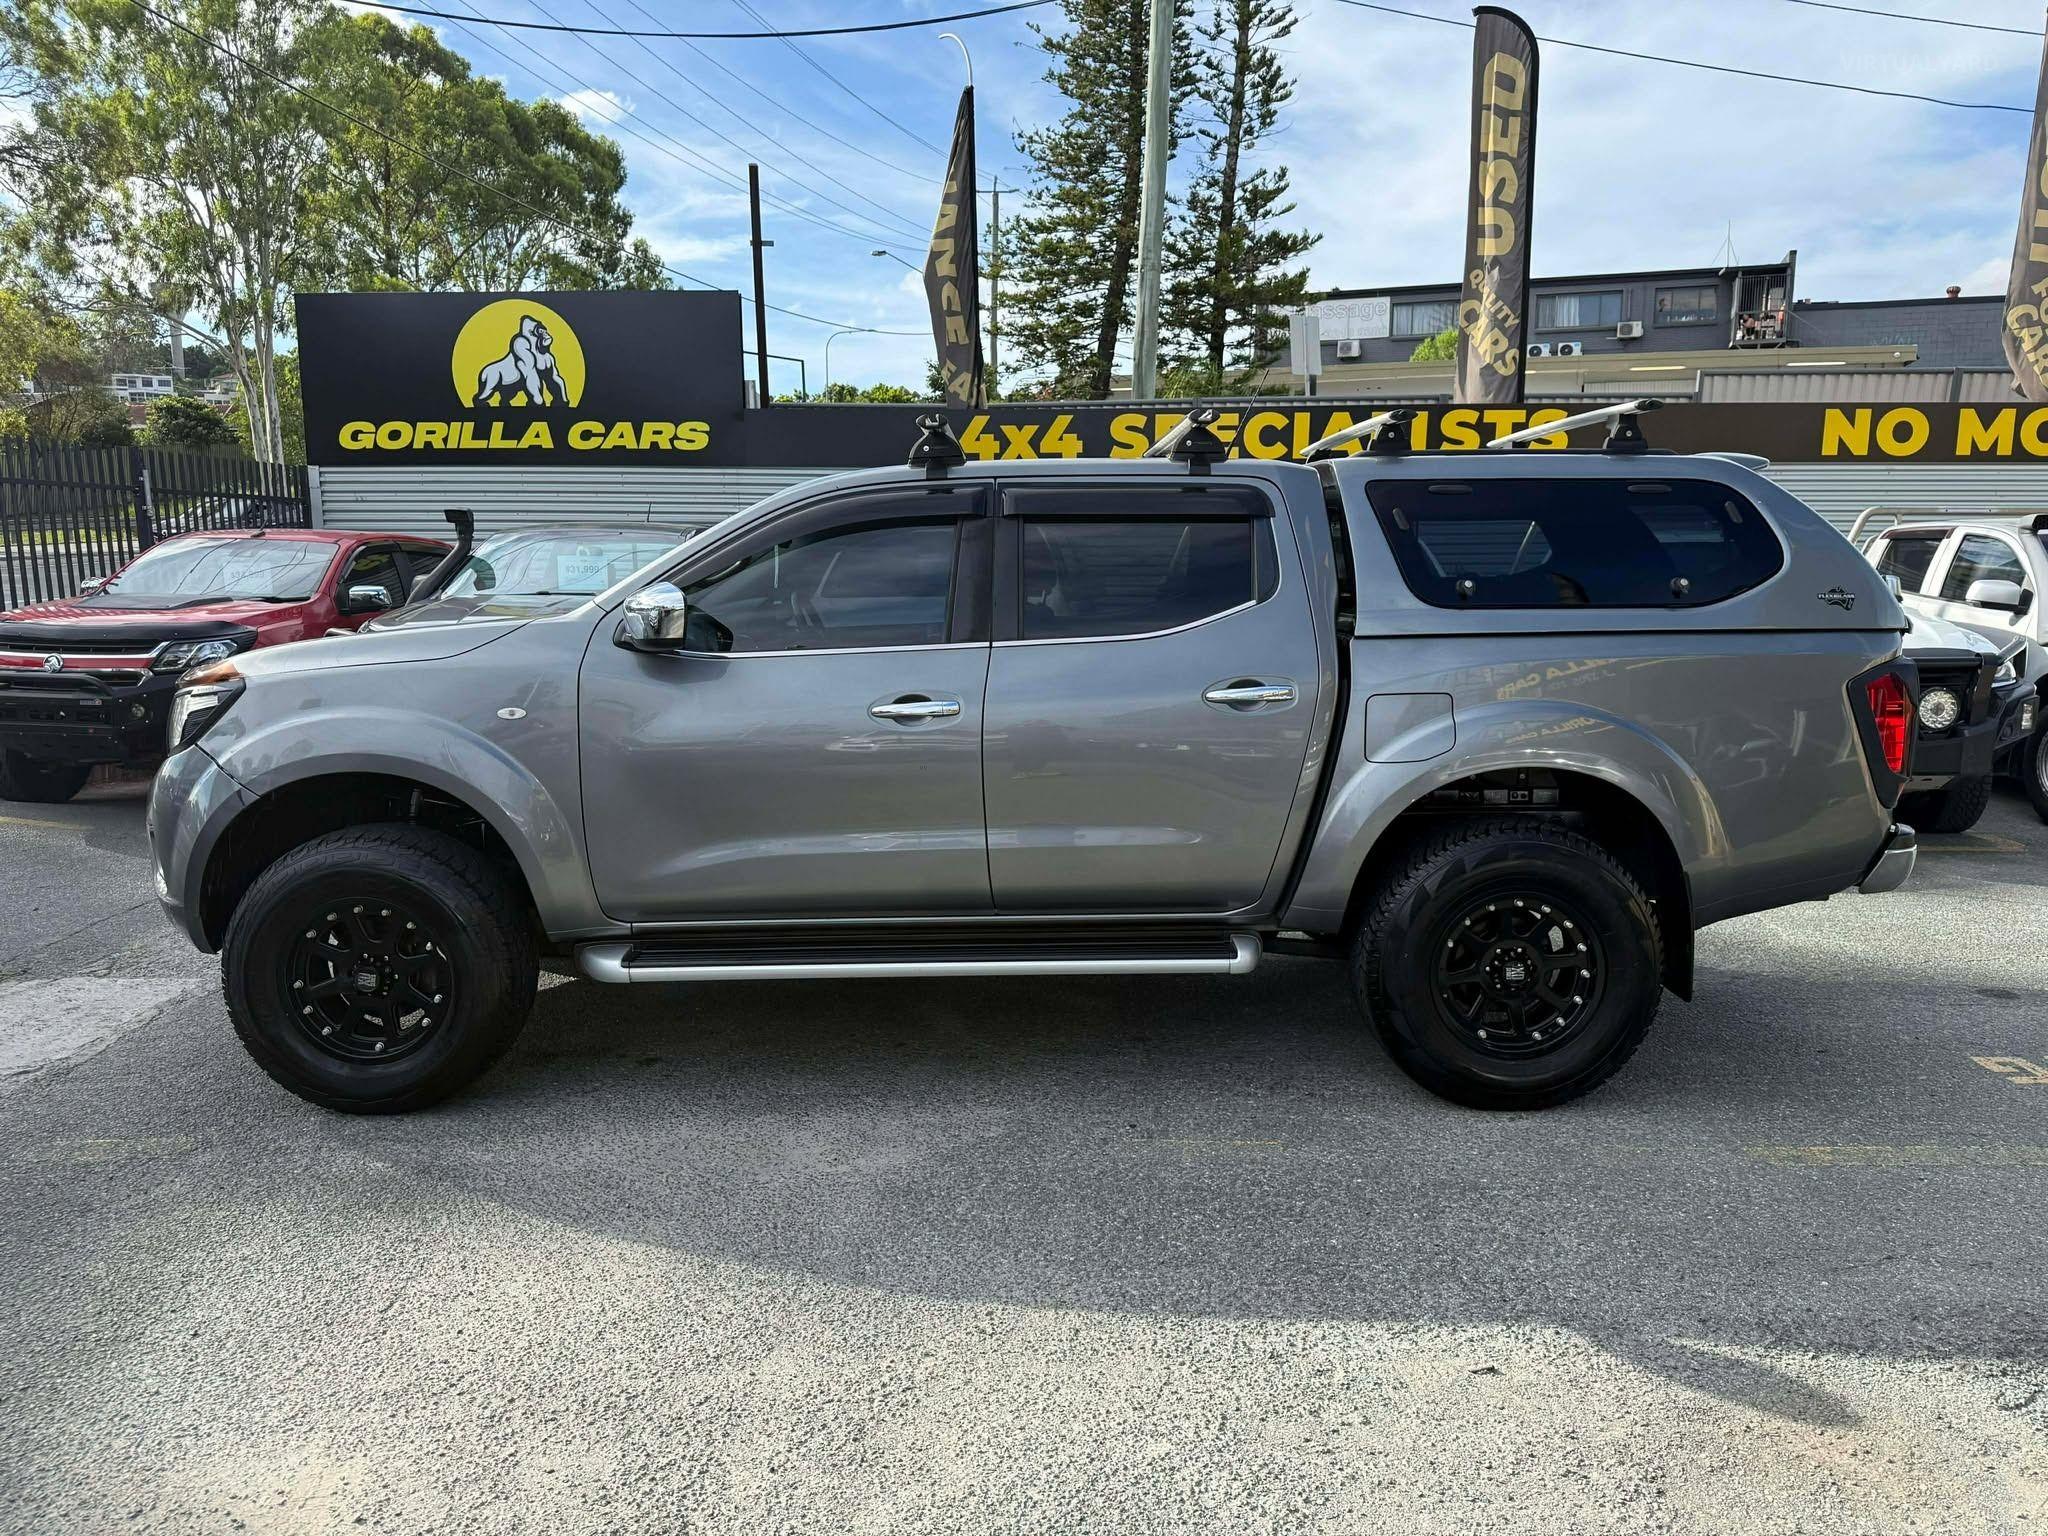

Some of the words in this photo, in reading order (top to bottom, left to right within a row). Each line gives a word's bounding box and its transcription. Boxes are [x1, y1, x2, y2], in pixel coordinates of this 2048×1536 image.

[1477, 51, 1526, 256] USED
[1308, 301, 1388, 322] assage
[1460, 299, 1520, 376] CARS
[2005, 303, 2048, 389] CAR
[338, 421, 554, 450] GORILLA
[568, 421, 710, 450] CARS
[959, 414, 1083, 461] 4x4
[1109, 408, 1569, 461] SECIAISTS
[1821, 407, 1930, 457] NO
